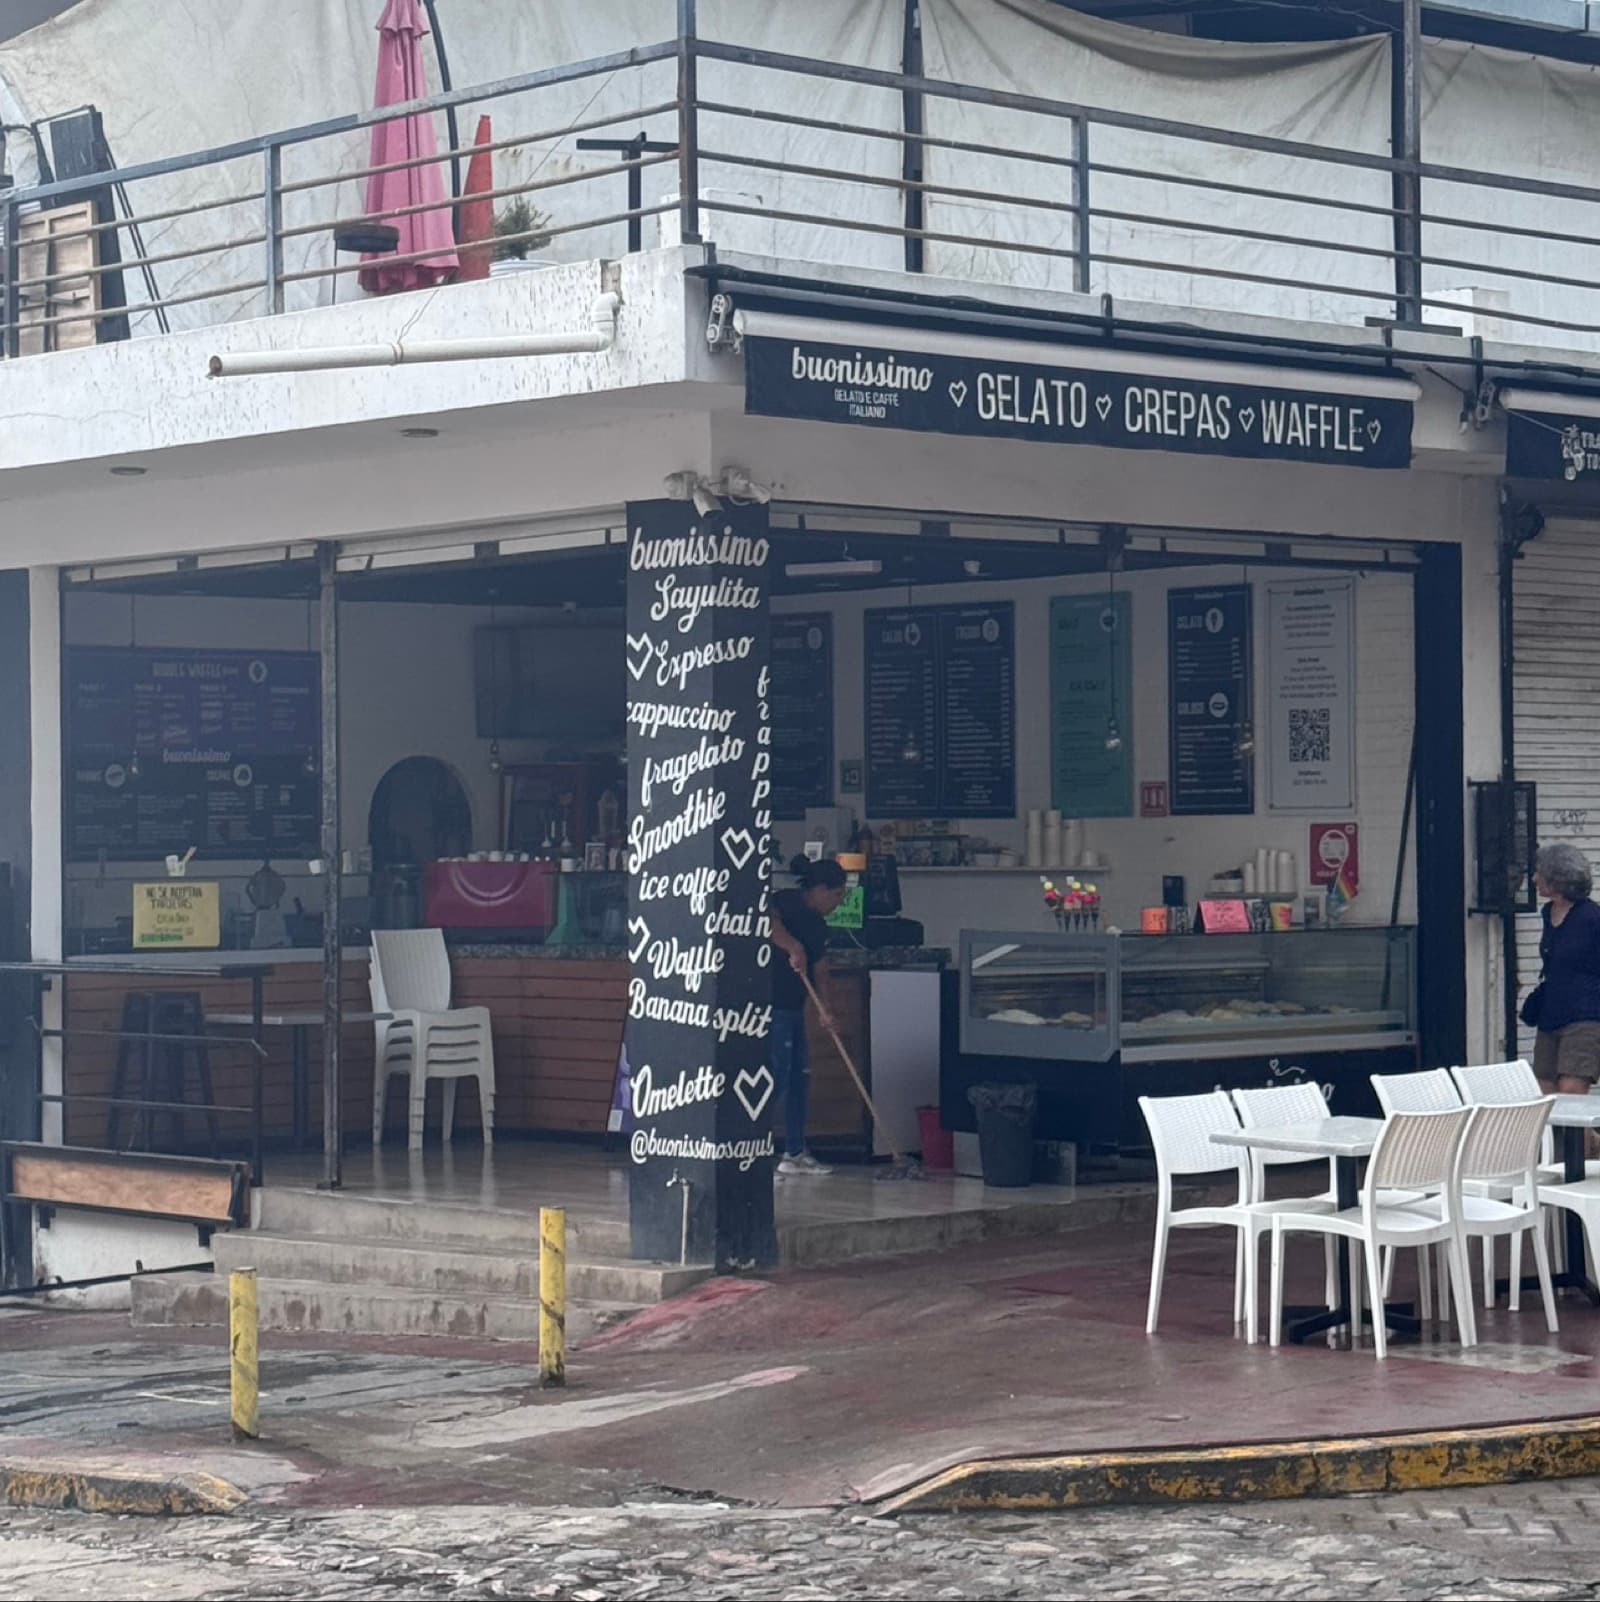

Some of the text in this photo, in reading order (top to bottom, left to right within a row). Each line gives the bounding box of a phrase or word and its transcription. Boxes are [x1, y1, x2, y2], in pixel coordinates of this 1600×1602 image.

[792, 346, 934, 392] buonissimo
[834, 388, 865, 404] GELATO
[865, 391, 872, 404] E
[849, 404, 886, 418] ITALIANO
[977, 373, 1364, 453] GELATO CREPAS WAFFLE
[630, 526, 770, 571] buonissimo
[651, 573, 760, 633] Sayulita
[656, 636, 755, 691] Expresso
[640, 735, 746, 807] fragelato
[628, 787, 727, 876] Smoothie
[639, 866, 730, 916] ice coffee
[704, 900, 753, 938] chai
[647, 937, 725, 993] Waffle
[629, 977, 773, 1043] Banana split
[630, 1064, 726, 1119] Omelette
